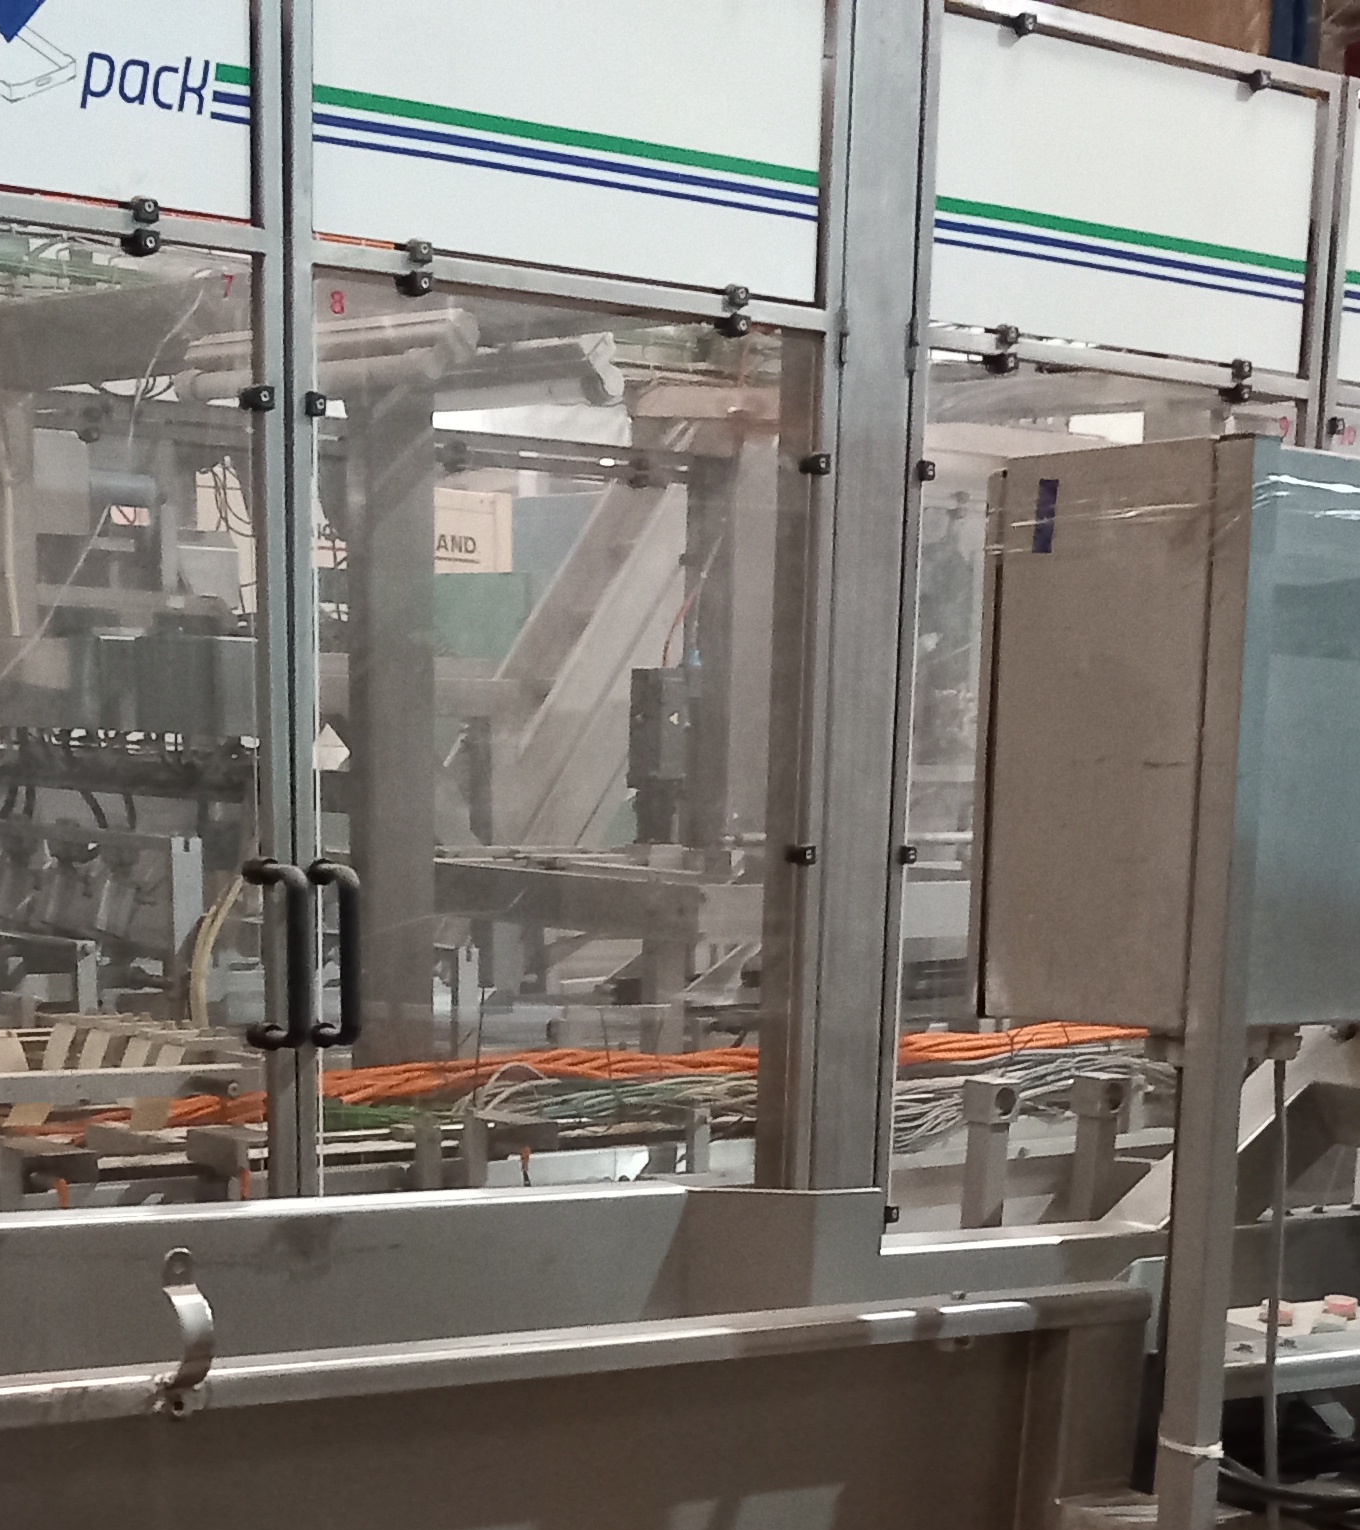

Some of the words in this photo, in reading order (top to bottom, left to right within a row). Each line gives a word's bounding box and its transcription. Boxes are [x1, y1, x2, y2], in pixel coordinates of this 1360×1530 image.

[80, 52, 210, 115] pack
[223, 273, 234, 298] 7
[330, 290, 345, 314] 8
[1279, 416, 1290, 437] 9
